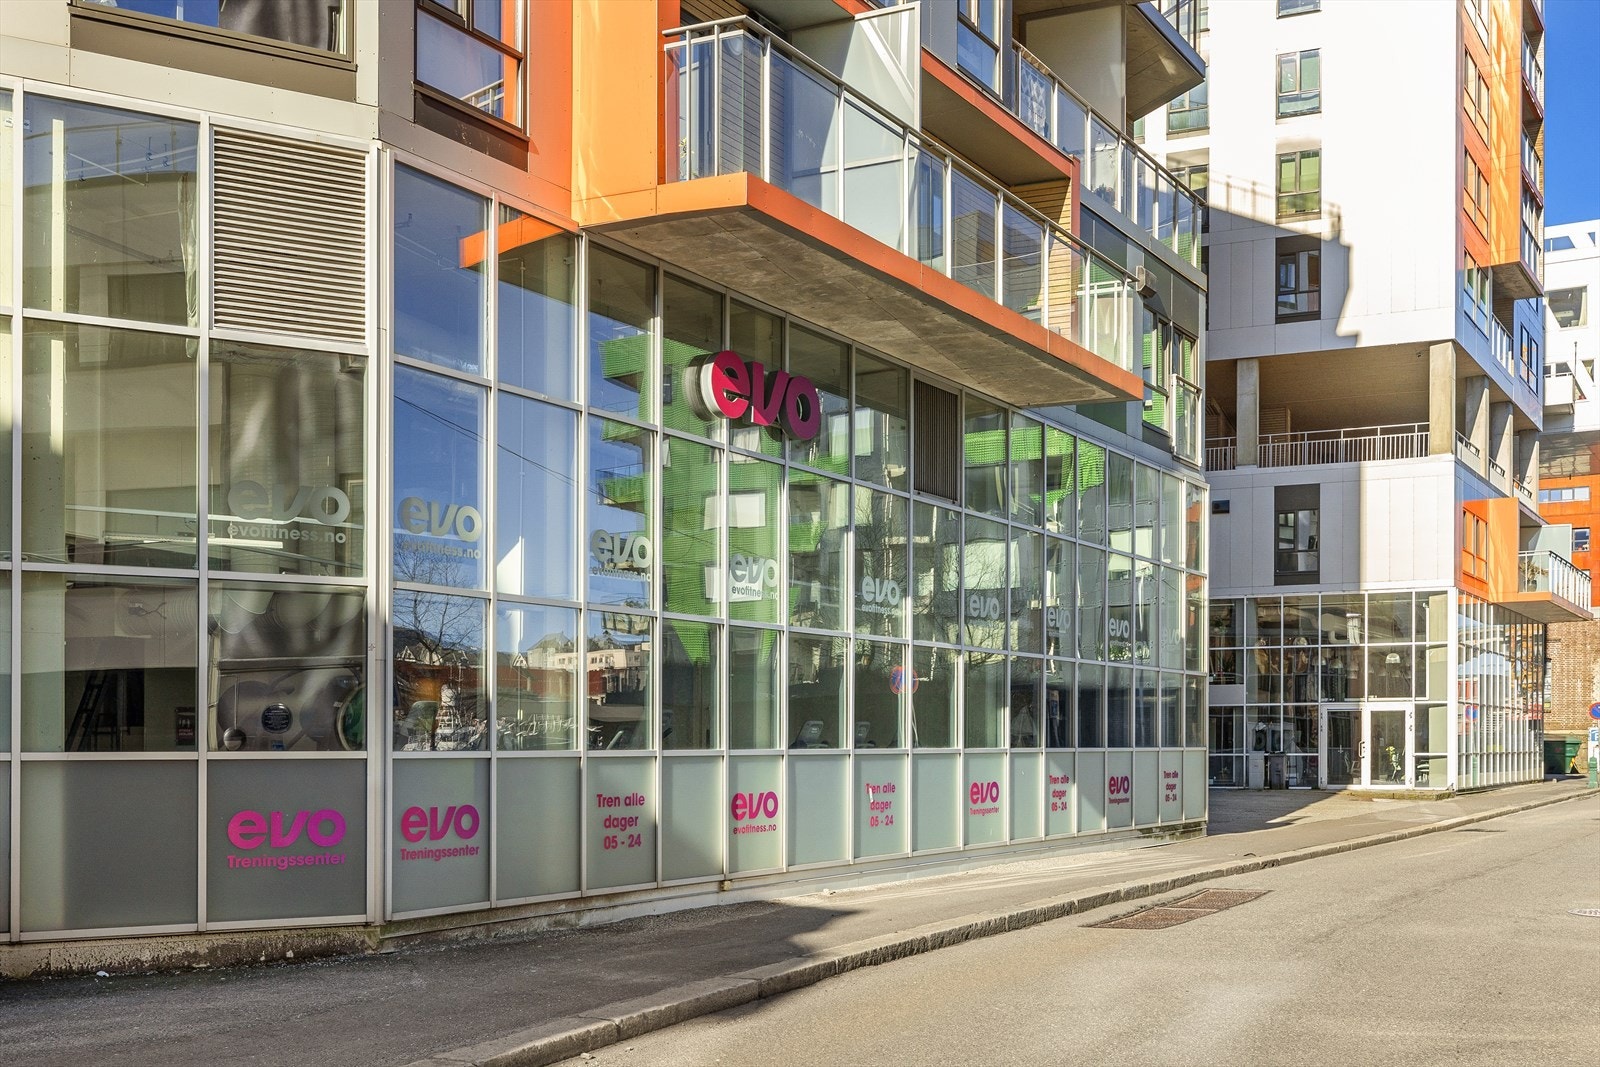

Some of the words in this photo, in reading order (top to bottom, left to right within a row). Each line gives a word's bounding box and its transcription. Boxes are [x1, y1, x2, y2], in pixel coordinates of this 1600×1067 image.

[703, 350, 821, 440] evo
[228, 480, 350, 525] evo
[400, 496, 482, 542] evo
[227, 523, 346, 544] evofitness.no
[590, 529, 651, 568] evo
[730, 553, 778, 587] evo
[862, 576, 900, 605] evo
[969, 594, 1000, 620] evo
[1047, 607, 1071, 628] evo
[1108, 618, 1130, 638] evo
[882, 782, 896, 793] alle
[1049, 774, 1060, 784] Tren
[1108, 775, 1130, 795] evo
[597, 794, 621, 808] Tren
[624, 793, 645, 807] alle
[969, 781, 1000, 805] evo
[1052, 789, 1067, 800] dager
[731, 791, 778, 821] evo
[870, 800, 892, 813] dager
[1061, 801, 1068, 810] 24
[227, 809, 347, 849] evo
[401, 804, 480, 842] evo
[604, 815, 639, 832] dager
[733, 823, 776, 835] evofitness.no
[870, 816, 879, 827] 05
[885, 815, 894, 826] 24
[603, 836, 618, 850] 05
[628, 834, 642, 848] 24
[227, 853, 346, 870] Treningssenter
[400, 844, 480, 861] Treningssenter
